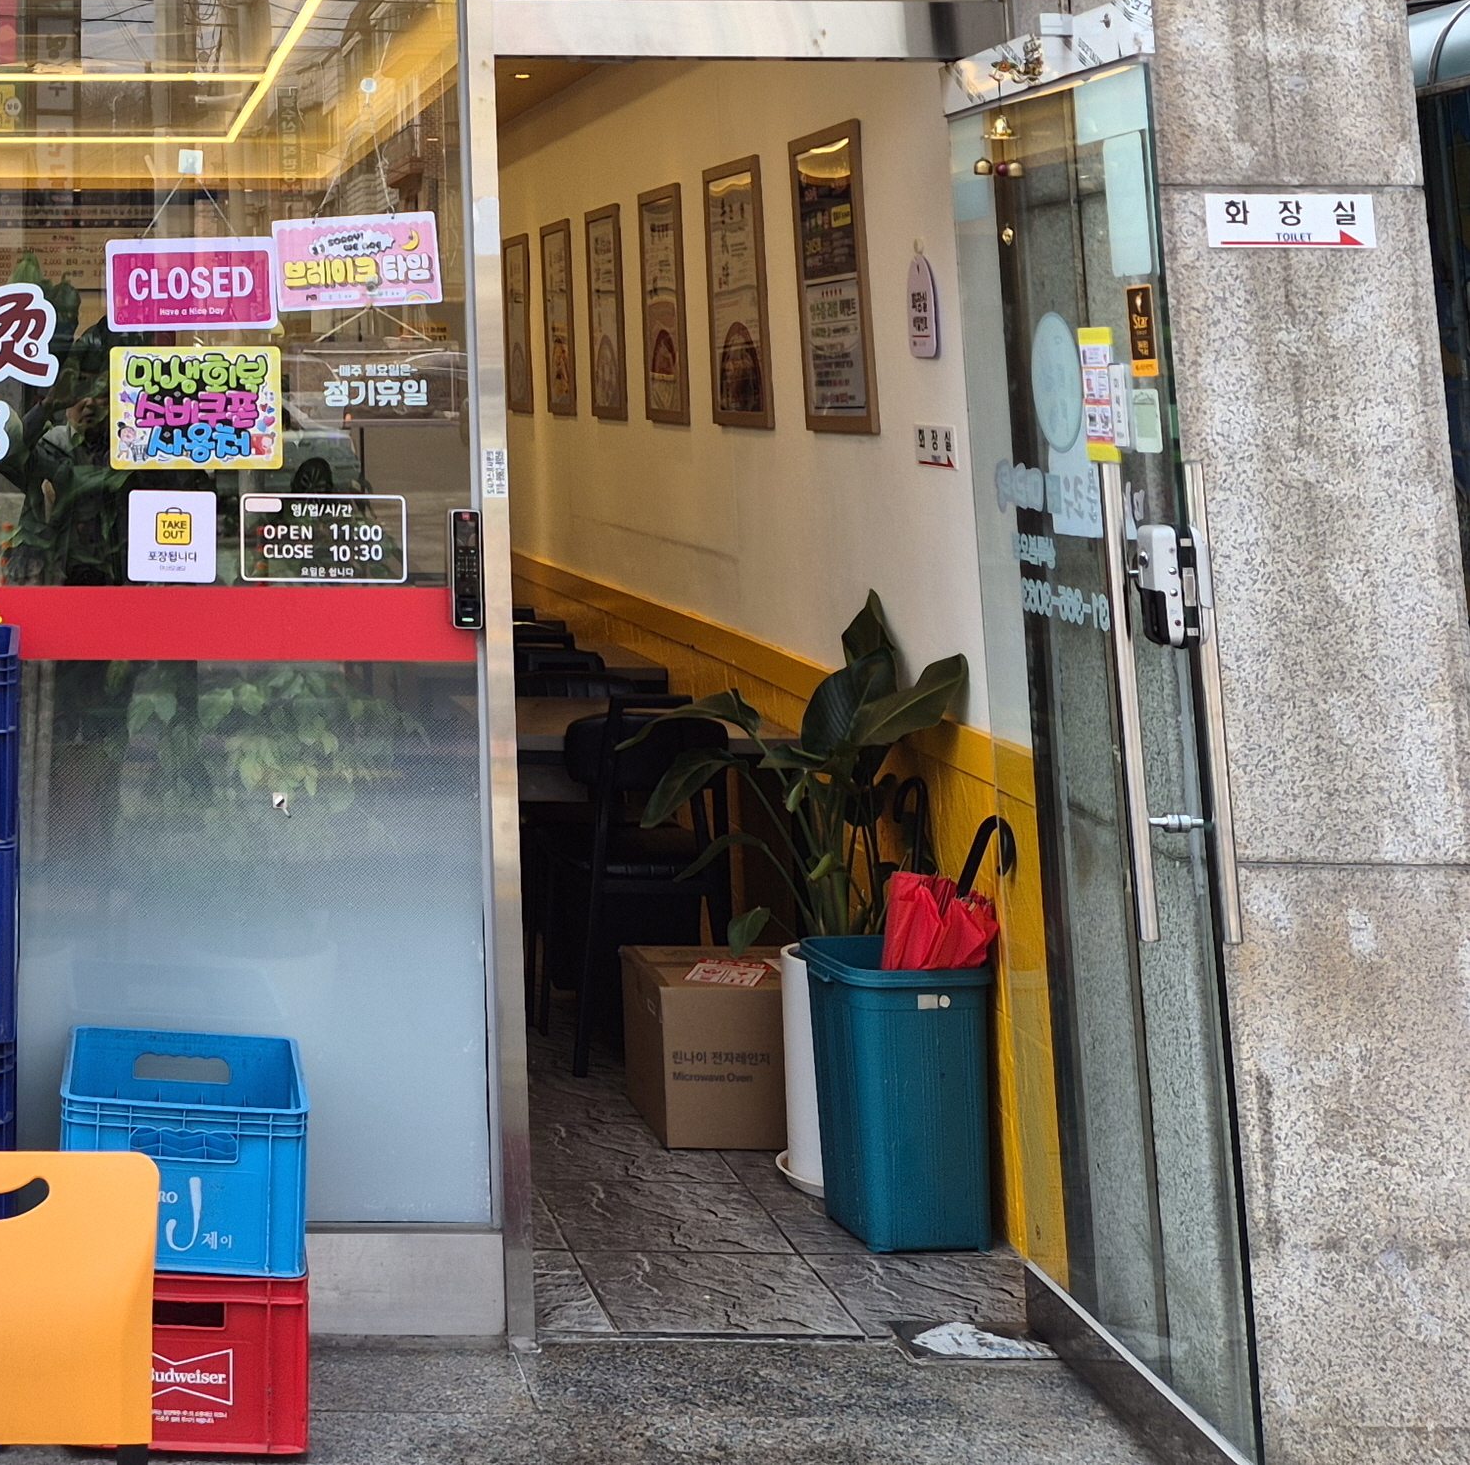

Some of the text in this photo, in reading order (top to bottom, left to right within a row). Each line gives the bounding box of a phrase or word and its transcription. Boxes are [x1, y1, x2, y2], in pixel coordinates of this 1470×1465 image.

[1275, 232, 1313, 243] TOILET
[283, 251, 435, 288] 브레이크 타임
[128, 265, 255, 302] CLOSED
[159, 307, 180, 316] Have
[189, 306, 208, 316] Nice
[209, 306, 225, 317] Day
[126, 353, 267, 394] 민생회복
[323, 379, 429, 407] 정기휴일
[135, 391, 259, 429] 소비쿠폰
[147, 422, 251, 463] 사용처
[160, 519, 188, 530] TAKE
[162, 529, 185, 539] OUT
[263, 523, 383, 542] OPEN 11:00
[263, 543, 383, 562] CLOSE 10:30
[671, 1050, 771, 1066] 린나이 전자레인지
[672, 1072, 753, 1084] Microwave Oven
[201, 1231, 233, 1250] 제이
